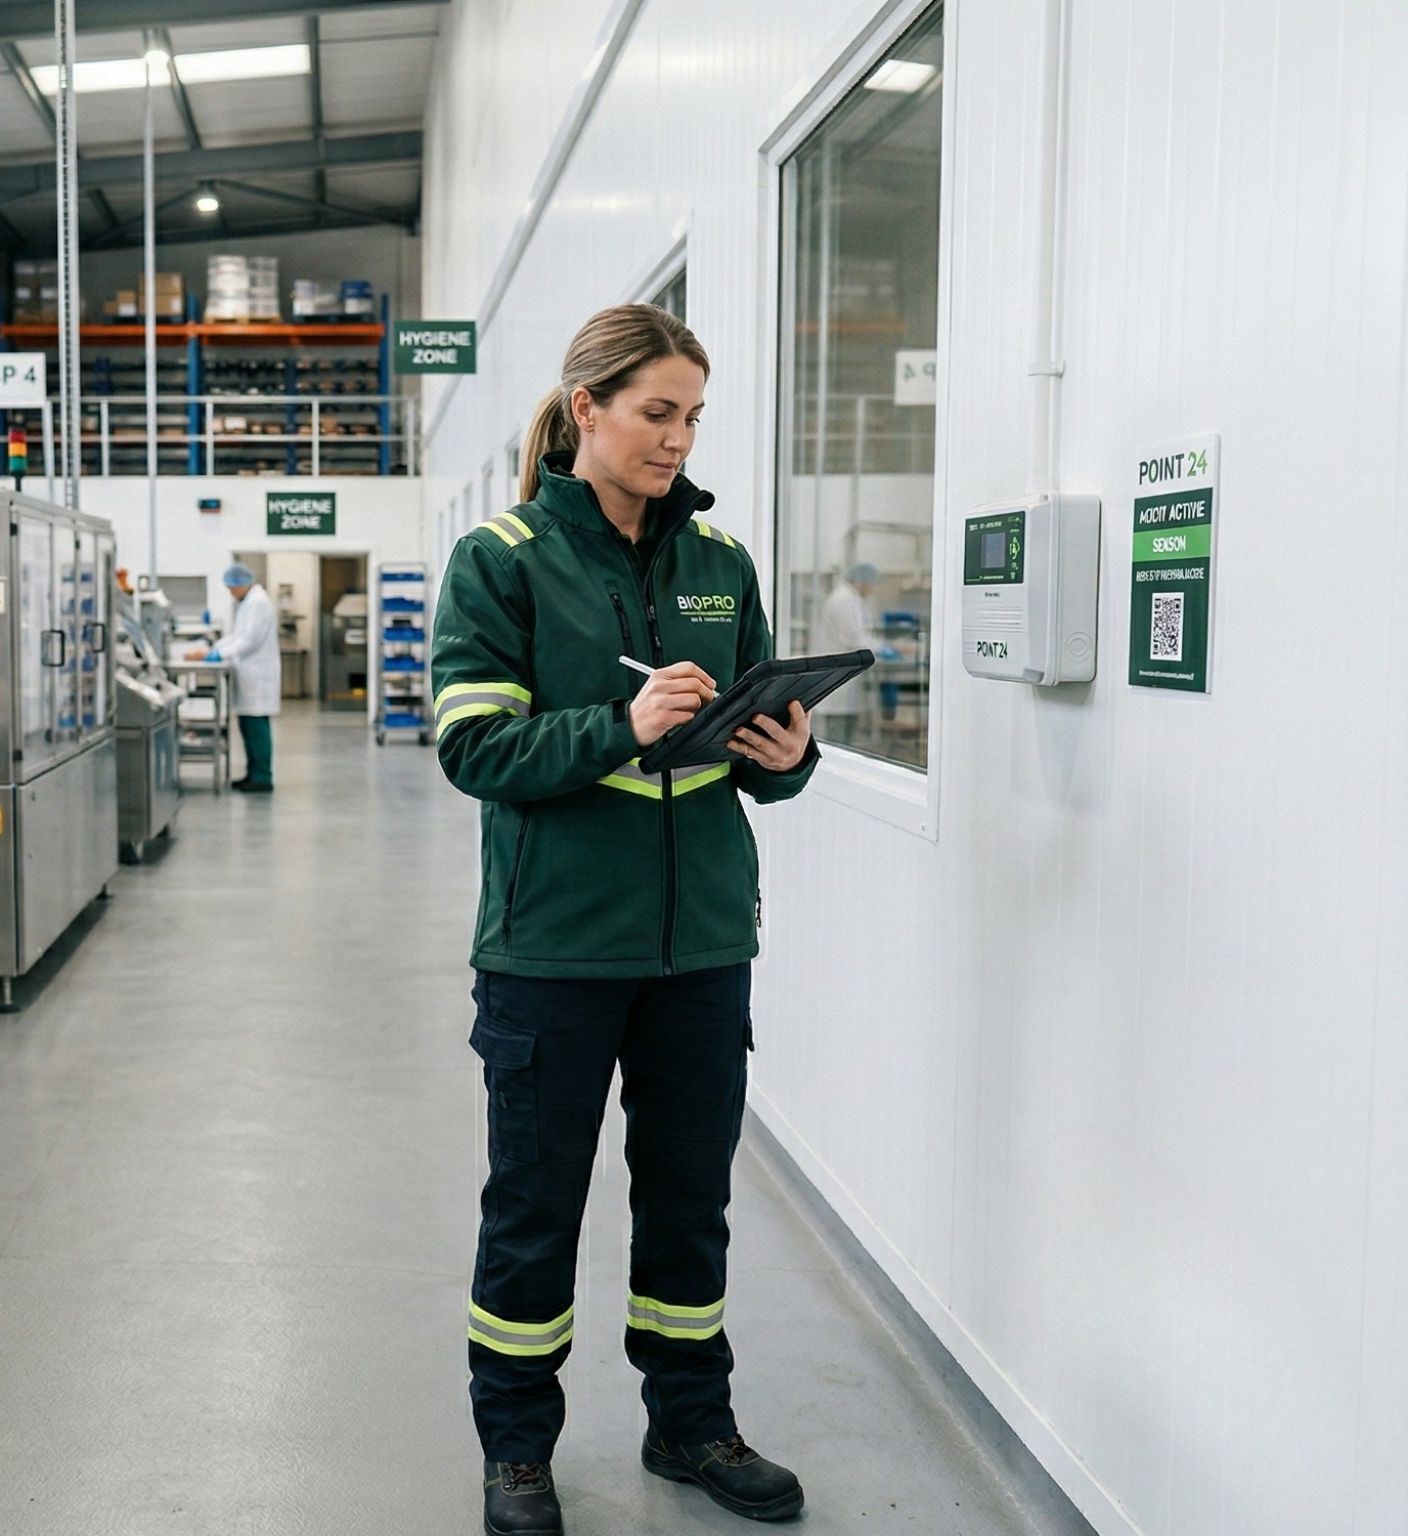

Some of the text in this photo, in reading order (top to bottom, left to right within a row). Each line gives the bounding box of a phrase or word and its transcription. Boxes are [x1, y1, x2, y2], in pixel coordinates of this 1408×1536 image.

[399, 331, 471, 347] HYGIENE
[412, 348, 458, 364] ZONE
[24, 366, 36, 384] 4
[1139, 448, 1208, 485] POINT 24
[268, 499, 332, 514] HYGIENE
[281, 515, 321, 529] ZONE
[677, 595, 735, 610] BIOPRO
